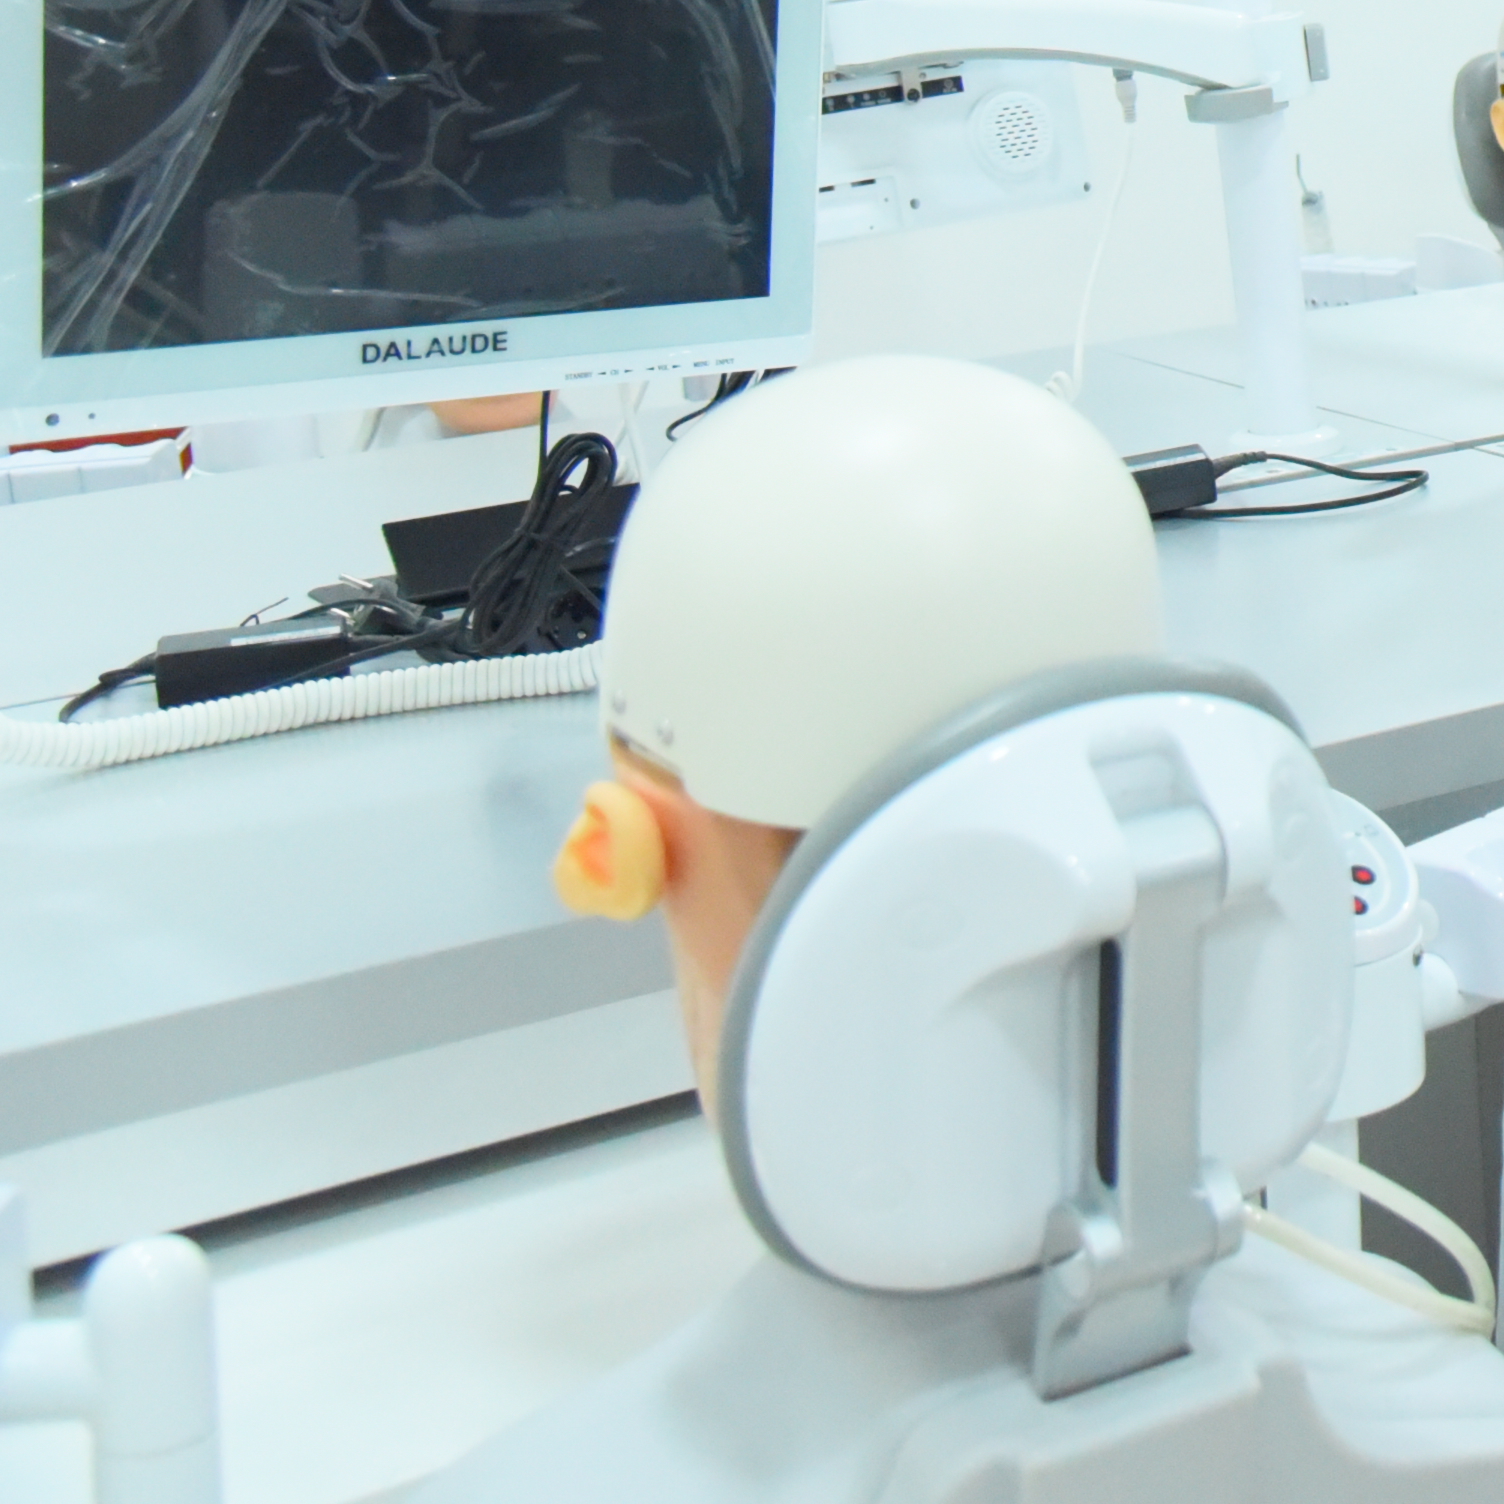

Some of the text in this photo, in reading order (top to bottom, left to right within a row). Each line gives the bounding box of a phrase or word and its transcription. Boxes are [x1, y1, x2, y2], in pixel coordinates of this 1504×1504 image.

[361, 330, 509, 364] DALAUDE
[564, 371, 593, 381] STANDBY
[715, 357, 735, 366] INPUT
